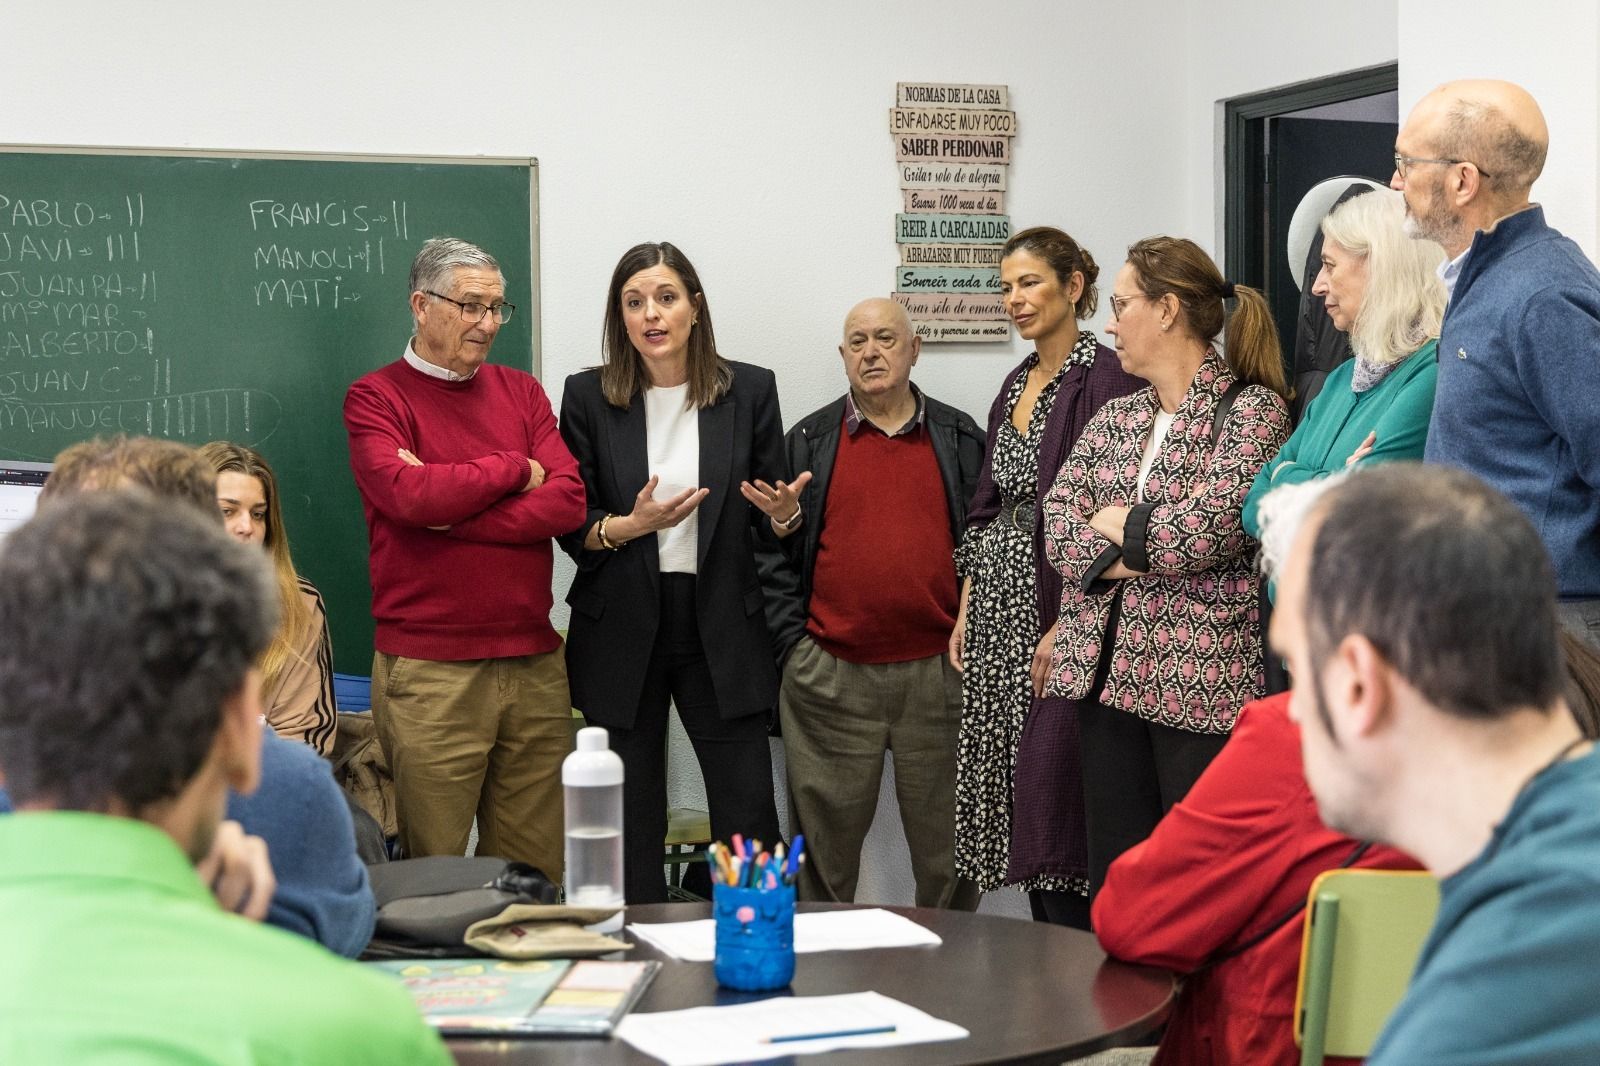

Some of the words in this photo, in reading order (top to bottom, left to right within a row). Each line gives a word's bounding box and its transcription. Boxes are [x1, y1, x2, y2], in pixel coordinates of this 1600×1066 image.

[906, 87, 945, 102] NORMAS
[948, 89, 960, 103] DE
[963, 89, 974, 103] LA
[977, 89, 1000, 104] CASA
[896, 112, 956, 129] ENFADARSE
[959, 114, 980, 130] MUY
[984, 115, 1010, 131] POCO
[902, 138, 938, 156] SABER
[943, 140, 1003, 158] PERDONAR
[954, 168, 966, 182] de
[911, 193, 936, 208] Besarse
[940, 195, 957, 209] 1000
[959, 199, 974, 209] veces
[977, 197, 984, 209] al
[902, 220, 927, 237] REIR
[930, 221, 937, 237] A
[940, 221, 1008, 239] CARCAJADAS
[907, 248, 951, 262] ABRAZARSE
[954, 248, 971, 263] MUY
[902, 272, 947, 287] Sonreír
[952, 275, 981, 288] cada
[53, 302, 124, 327] MAR
[932, 298, 951, 314] sólo
[954, 299, 966, 314] de
[934, 328, 938, 337] y
[940, 327, 968, 338] quererse
[983, 325, 1007, 334] montón
[1, 331, 138, 357] ALBERTO
[0, 369, 88, 395] JUAN
